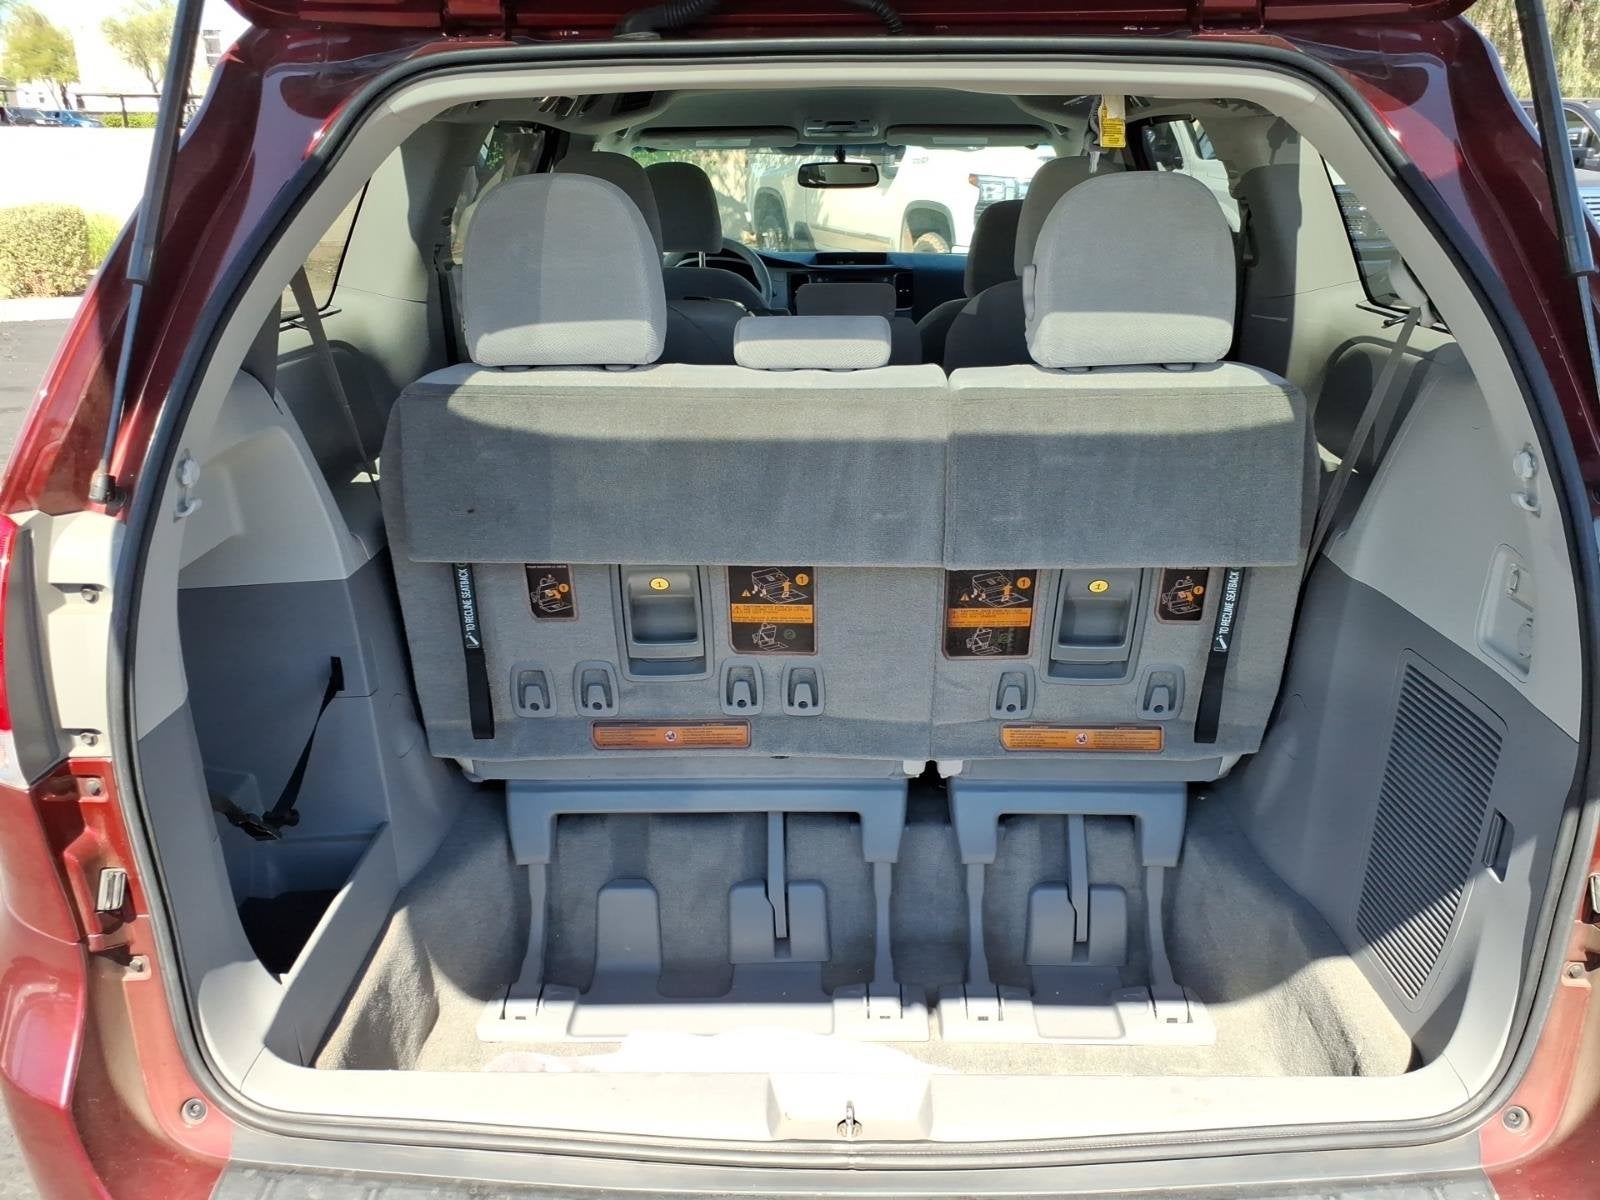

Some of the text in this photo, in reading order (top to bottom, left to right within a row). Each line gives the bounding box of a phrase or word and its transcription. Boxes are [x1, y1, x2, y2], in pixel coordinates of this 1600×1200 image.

[458, 568, 475, 631] TO RECLINE SEATBACK
[1218, 571, 1240, 634] TO RECLINE SEATBACK
